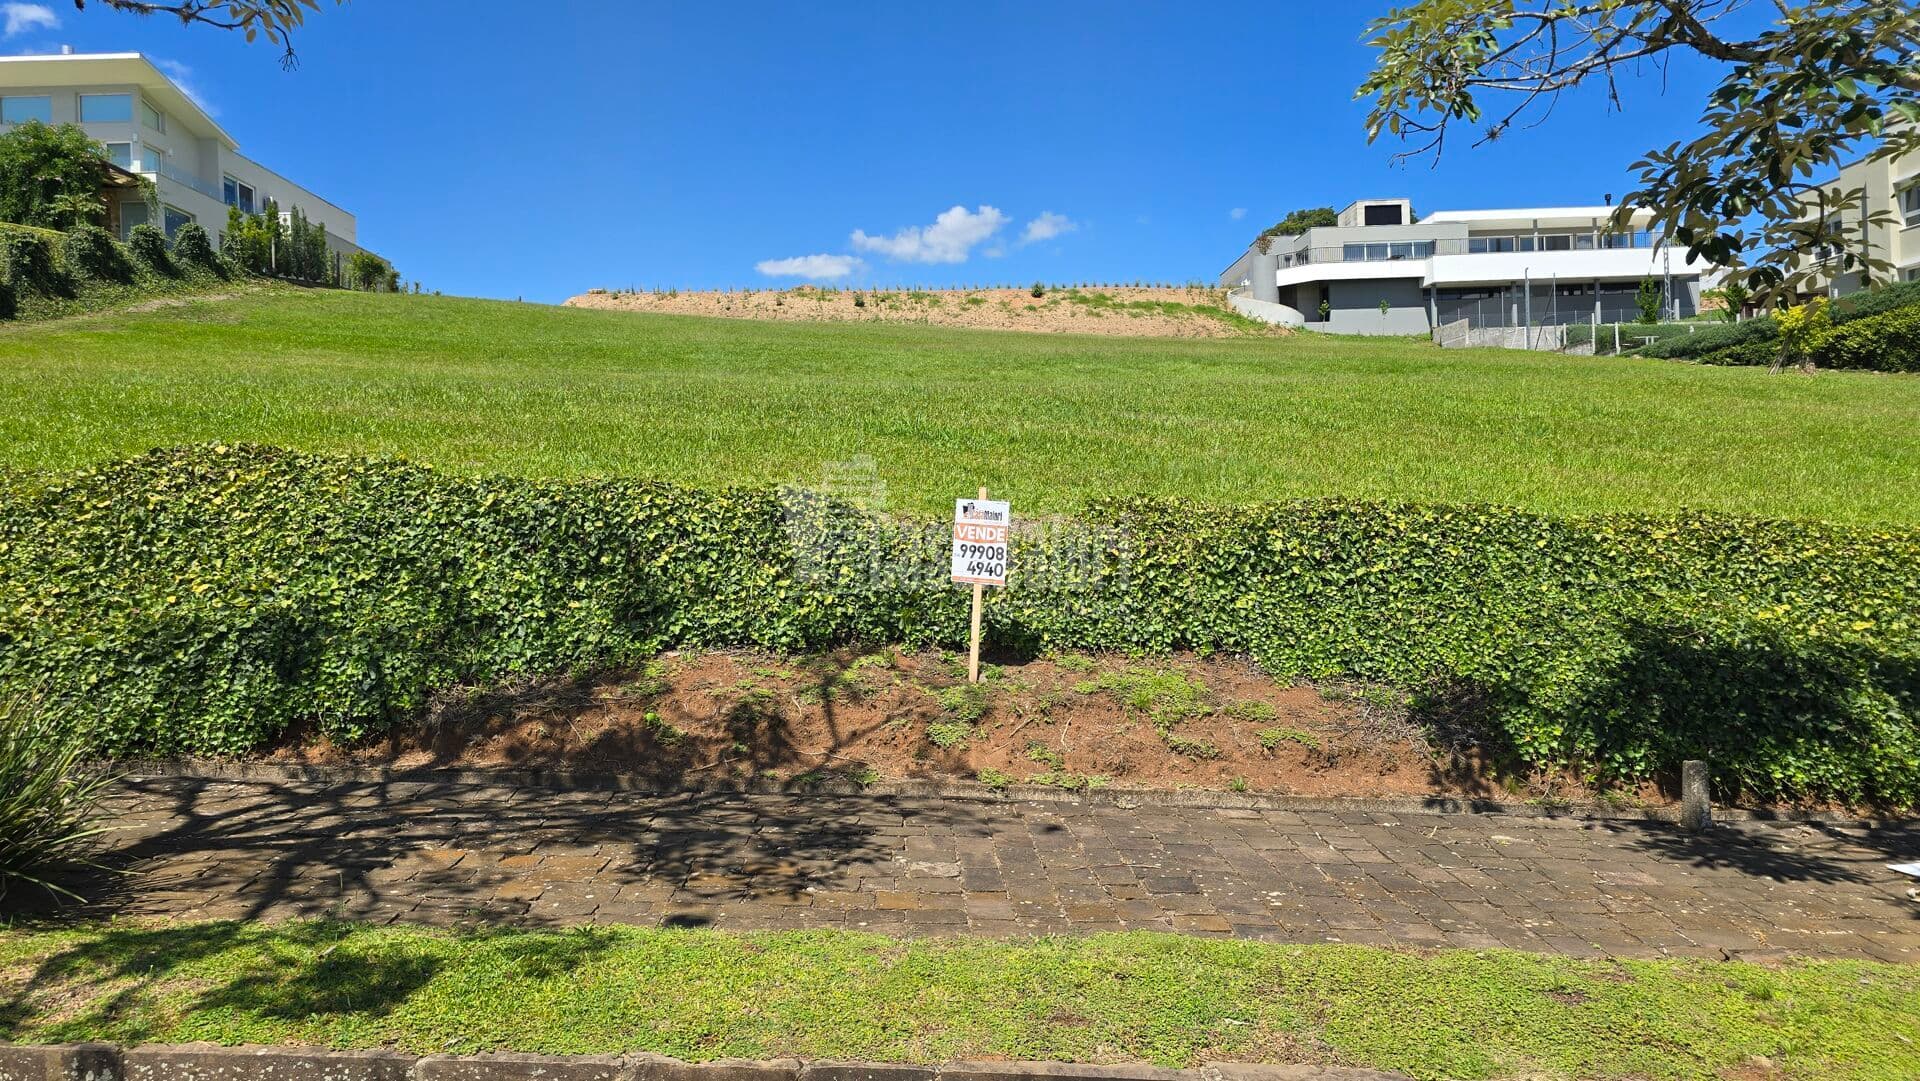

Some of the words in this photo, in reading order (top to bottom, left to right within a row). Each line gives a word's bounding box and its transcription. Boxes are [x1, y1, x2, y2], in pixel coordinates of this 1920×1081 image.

[956, 524, 1006, 542] VENDE
[960, 544, 1005, 561] 99908
[967, 560, 1004, 577] 4940
